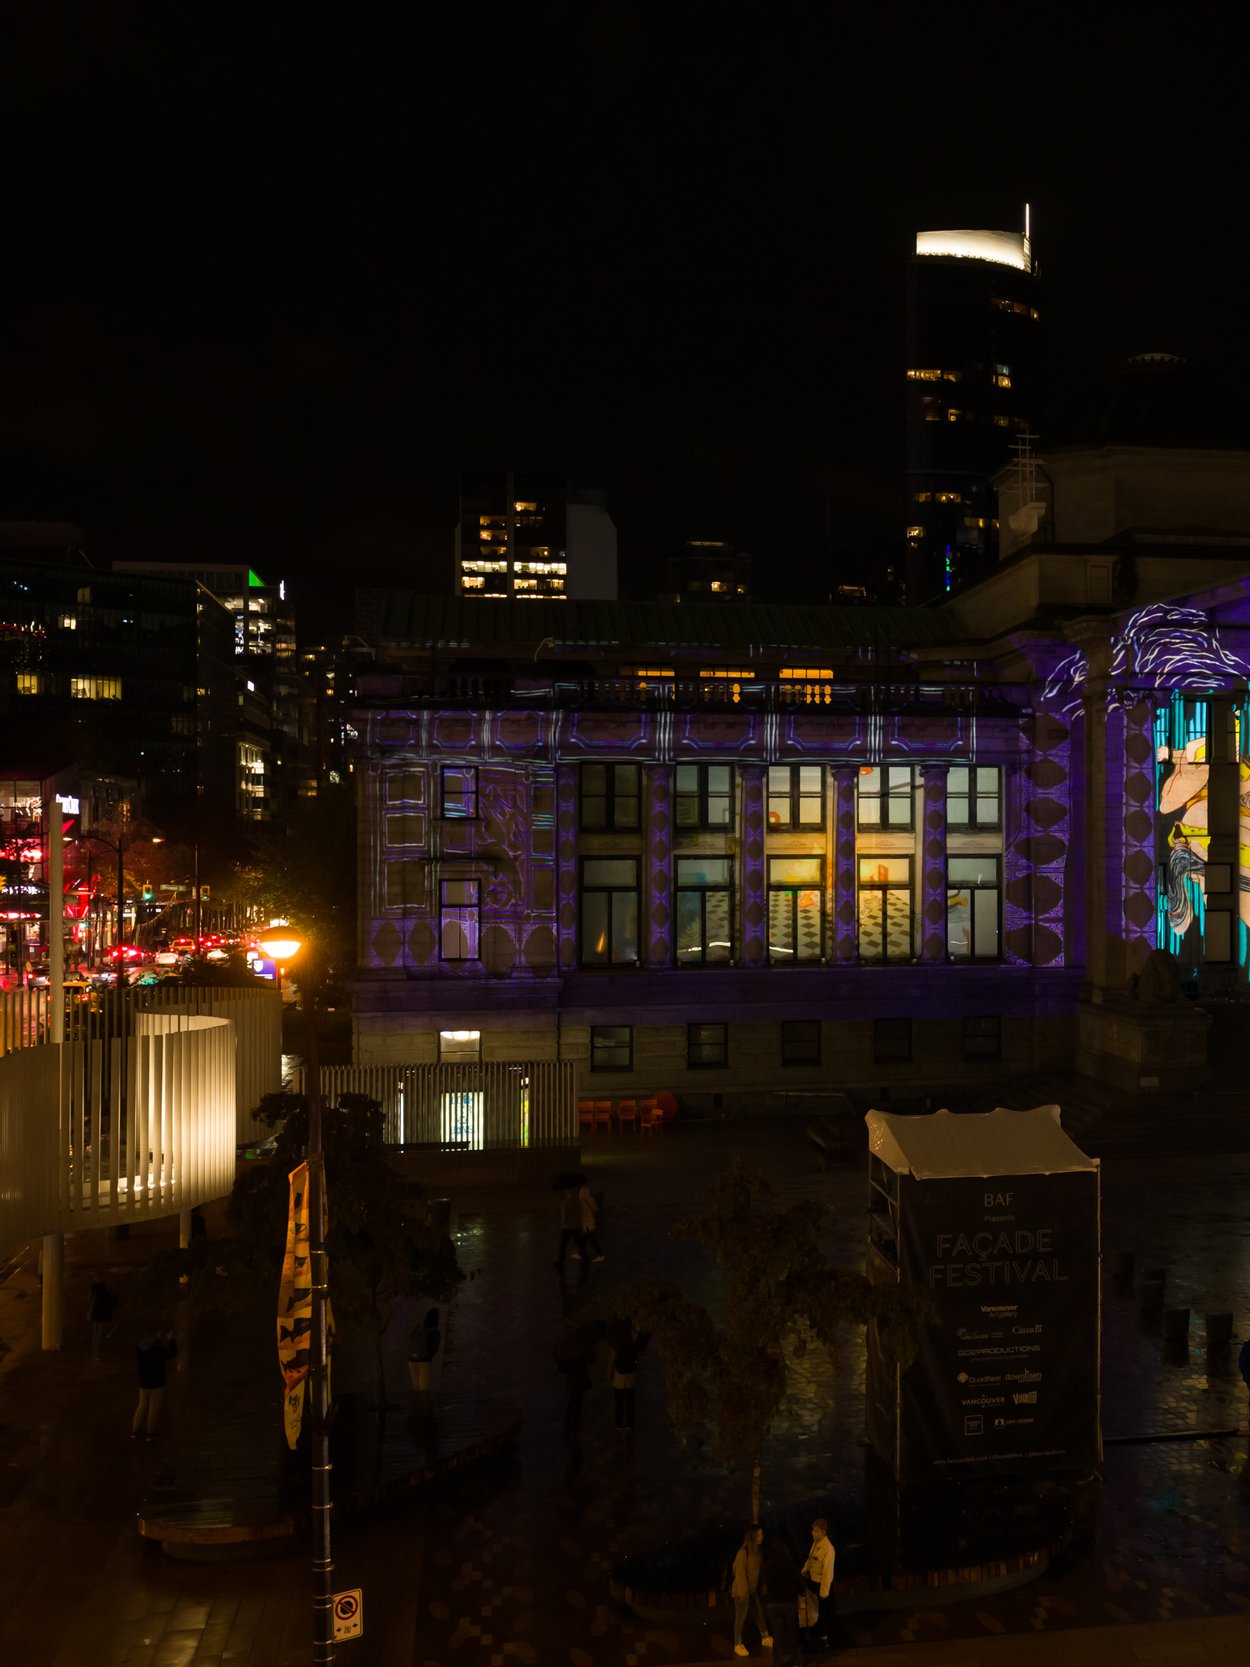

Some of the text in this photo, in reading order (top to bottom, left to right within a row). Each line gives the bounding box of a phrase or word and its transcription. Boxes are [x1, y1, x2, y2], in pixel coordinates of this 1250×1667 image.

[984, 1192, 1015, 1207] BAF
[936, 1229, 1054, 1261] FAÇADE
[929, 1258, 1070, 1289] FESTIVAL
[980, 1304, 1018, 1313] Vancouver
[961, 1396, 1006, 1405] VANCOUVER
